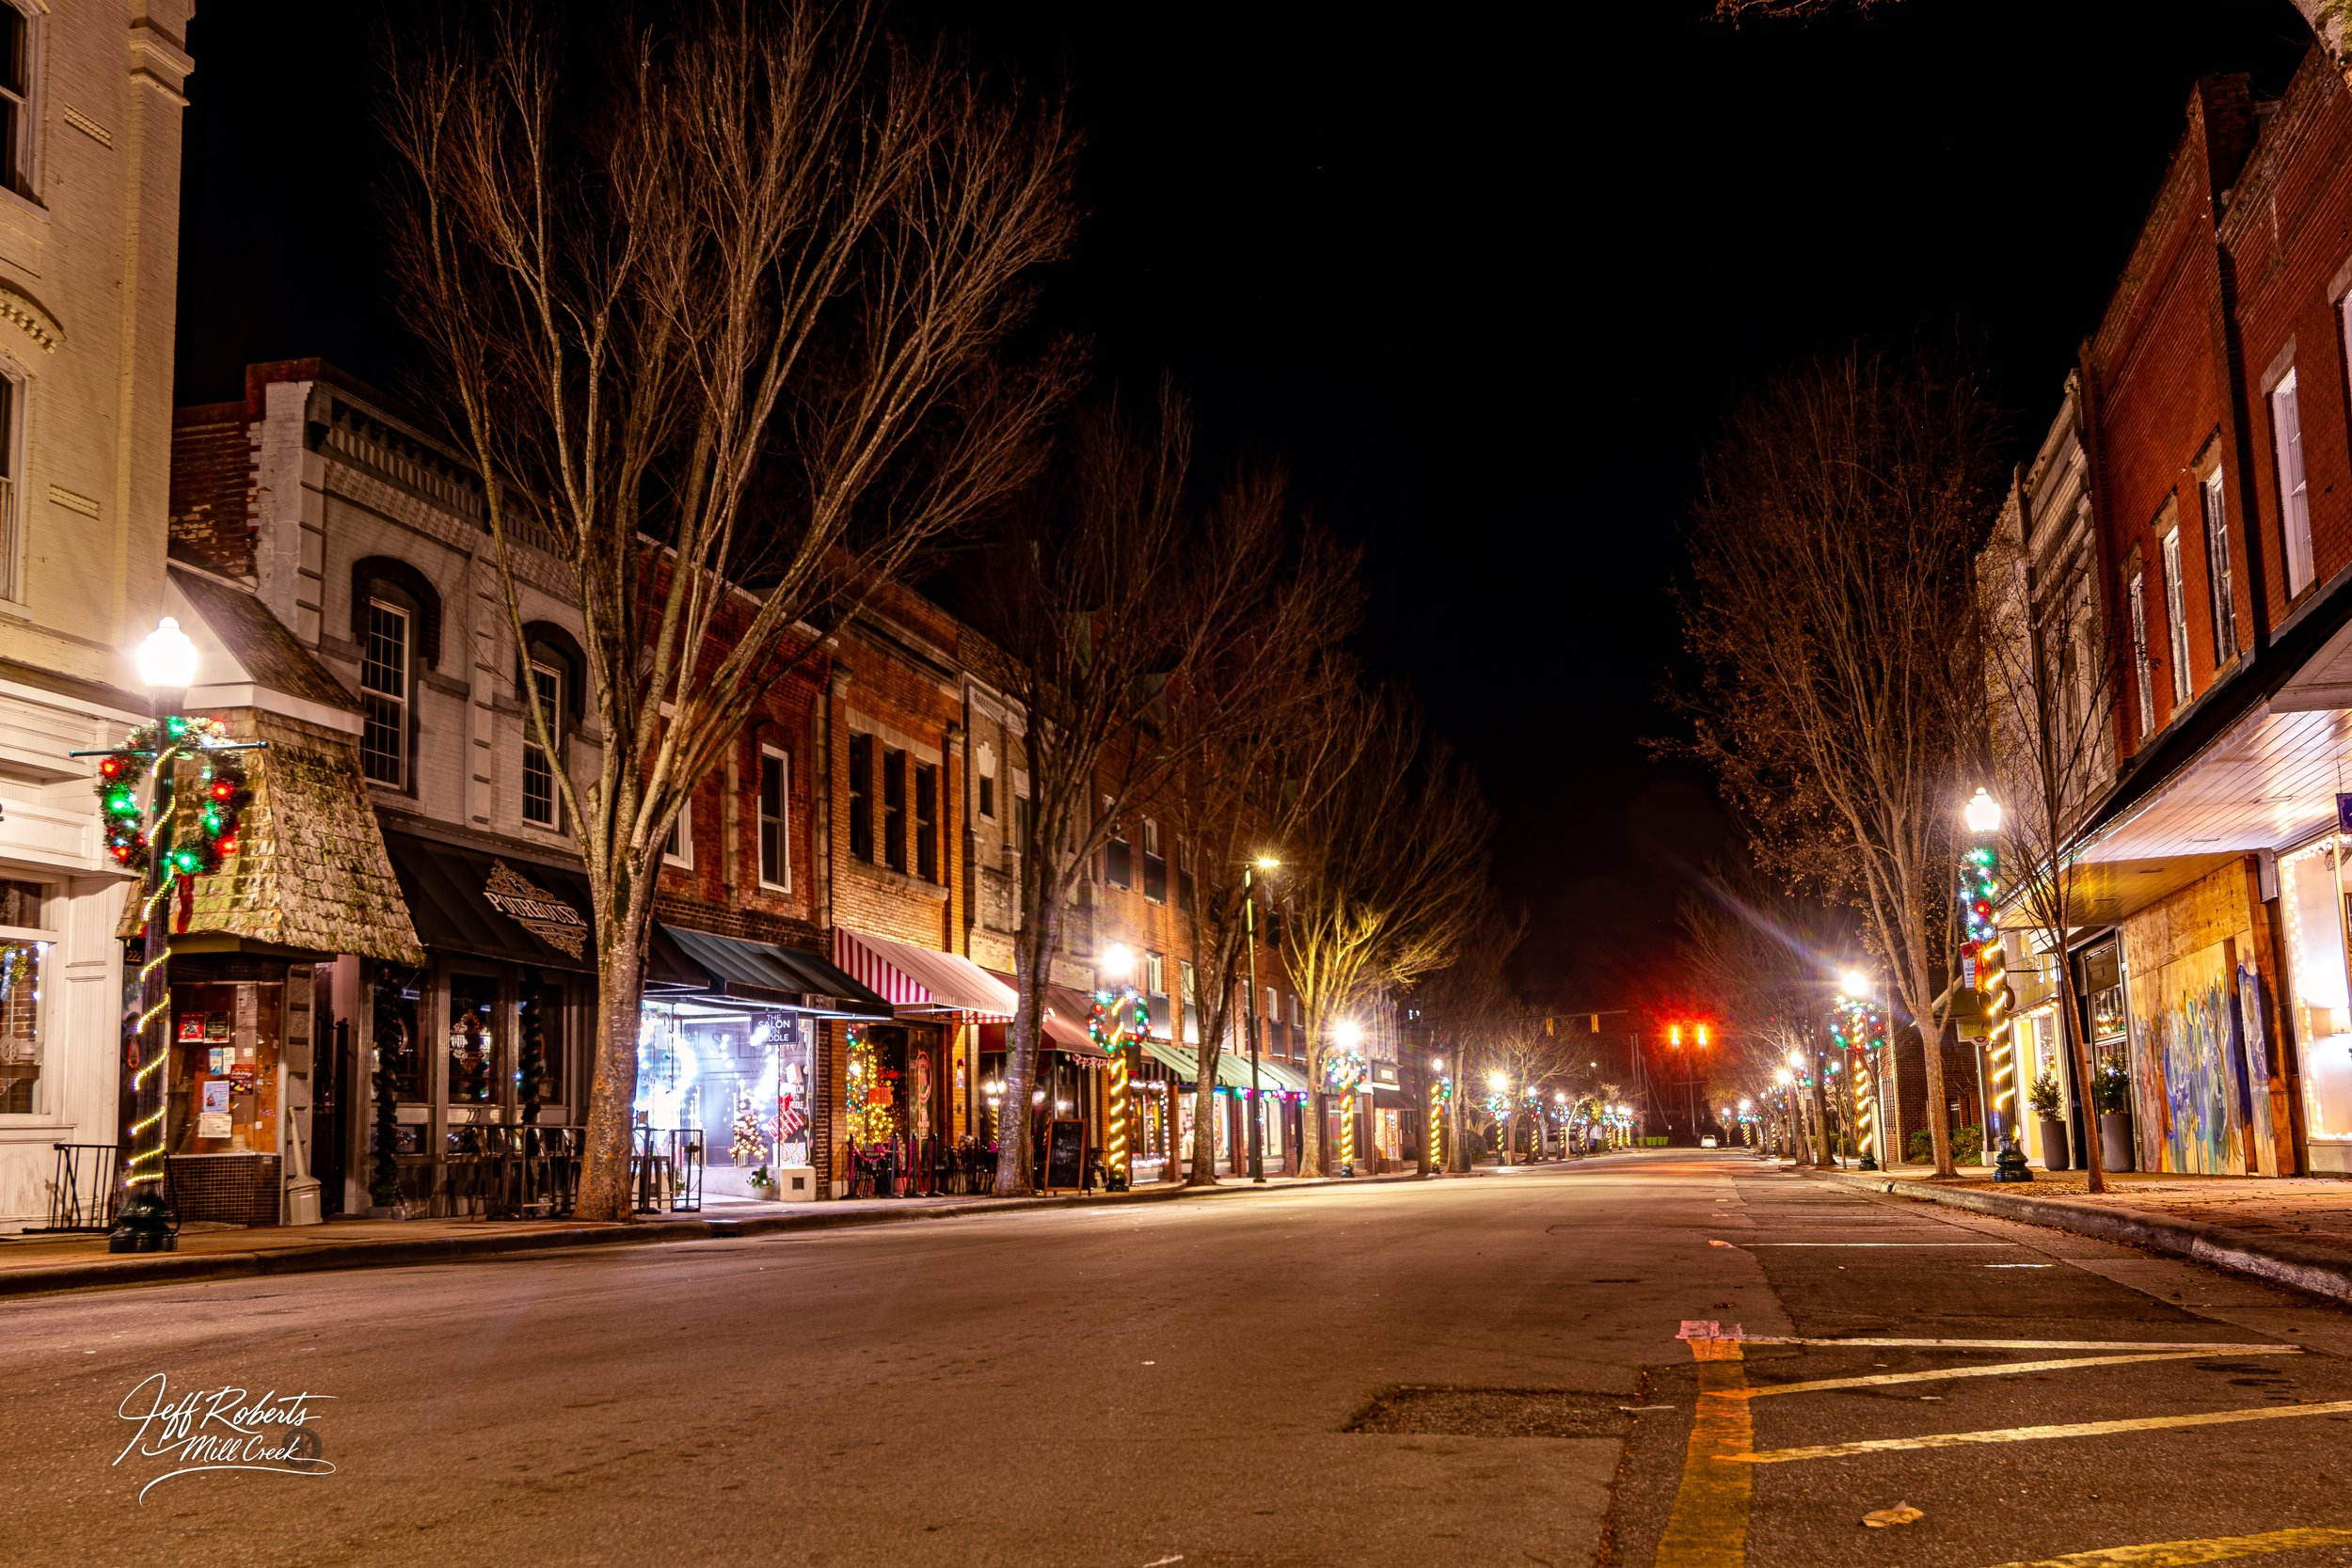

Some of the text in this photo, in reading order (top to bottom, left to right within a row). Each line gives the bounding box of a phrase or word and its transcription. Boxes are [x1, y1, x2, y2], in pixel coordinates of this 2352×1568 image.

[483, 892, 588, 927] POURHOUSE
[757, 1020, 790, 1029] SALON
[761, 1034, 789, 1042] DDLE
[466, 1109, 482, 1123] 222
